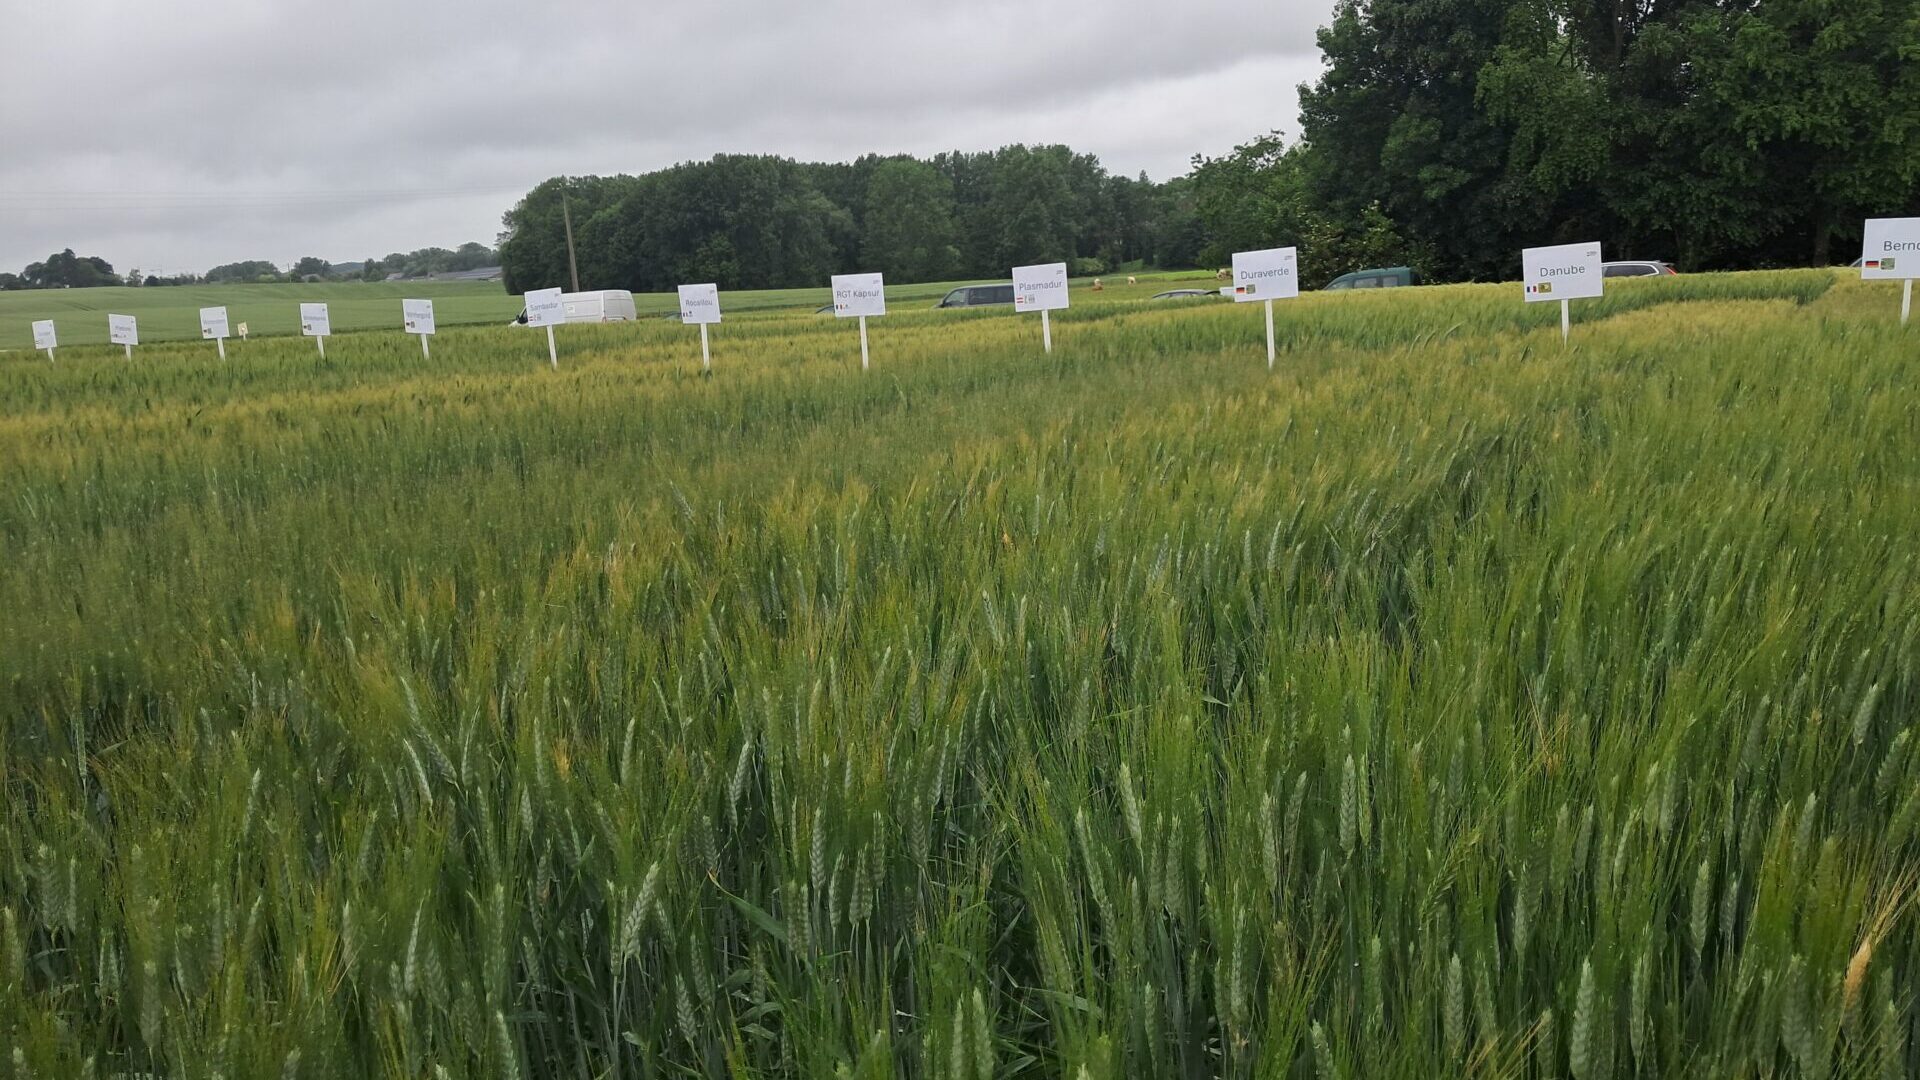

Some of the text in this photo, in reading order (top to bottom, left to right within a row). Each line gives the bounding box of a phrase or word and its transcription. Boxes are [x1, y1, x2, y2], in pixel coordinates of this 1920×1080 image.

[1240, 267, 1289, 280] Duraverde
[1539, 265, 1586, 277] Danube
[1019, 280, 1062, 291] Plasmadur
[836, 290, 880, 299] RGT Kapsur
